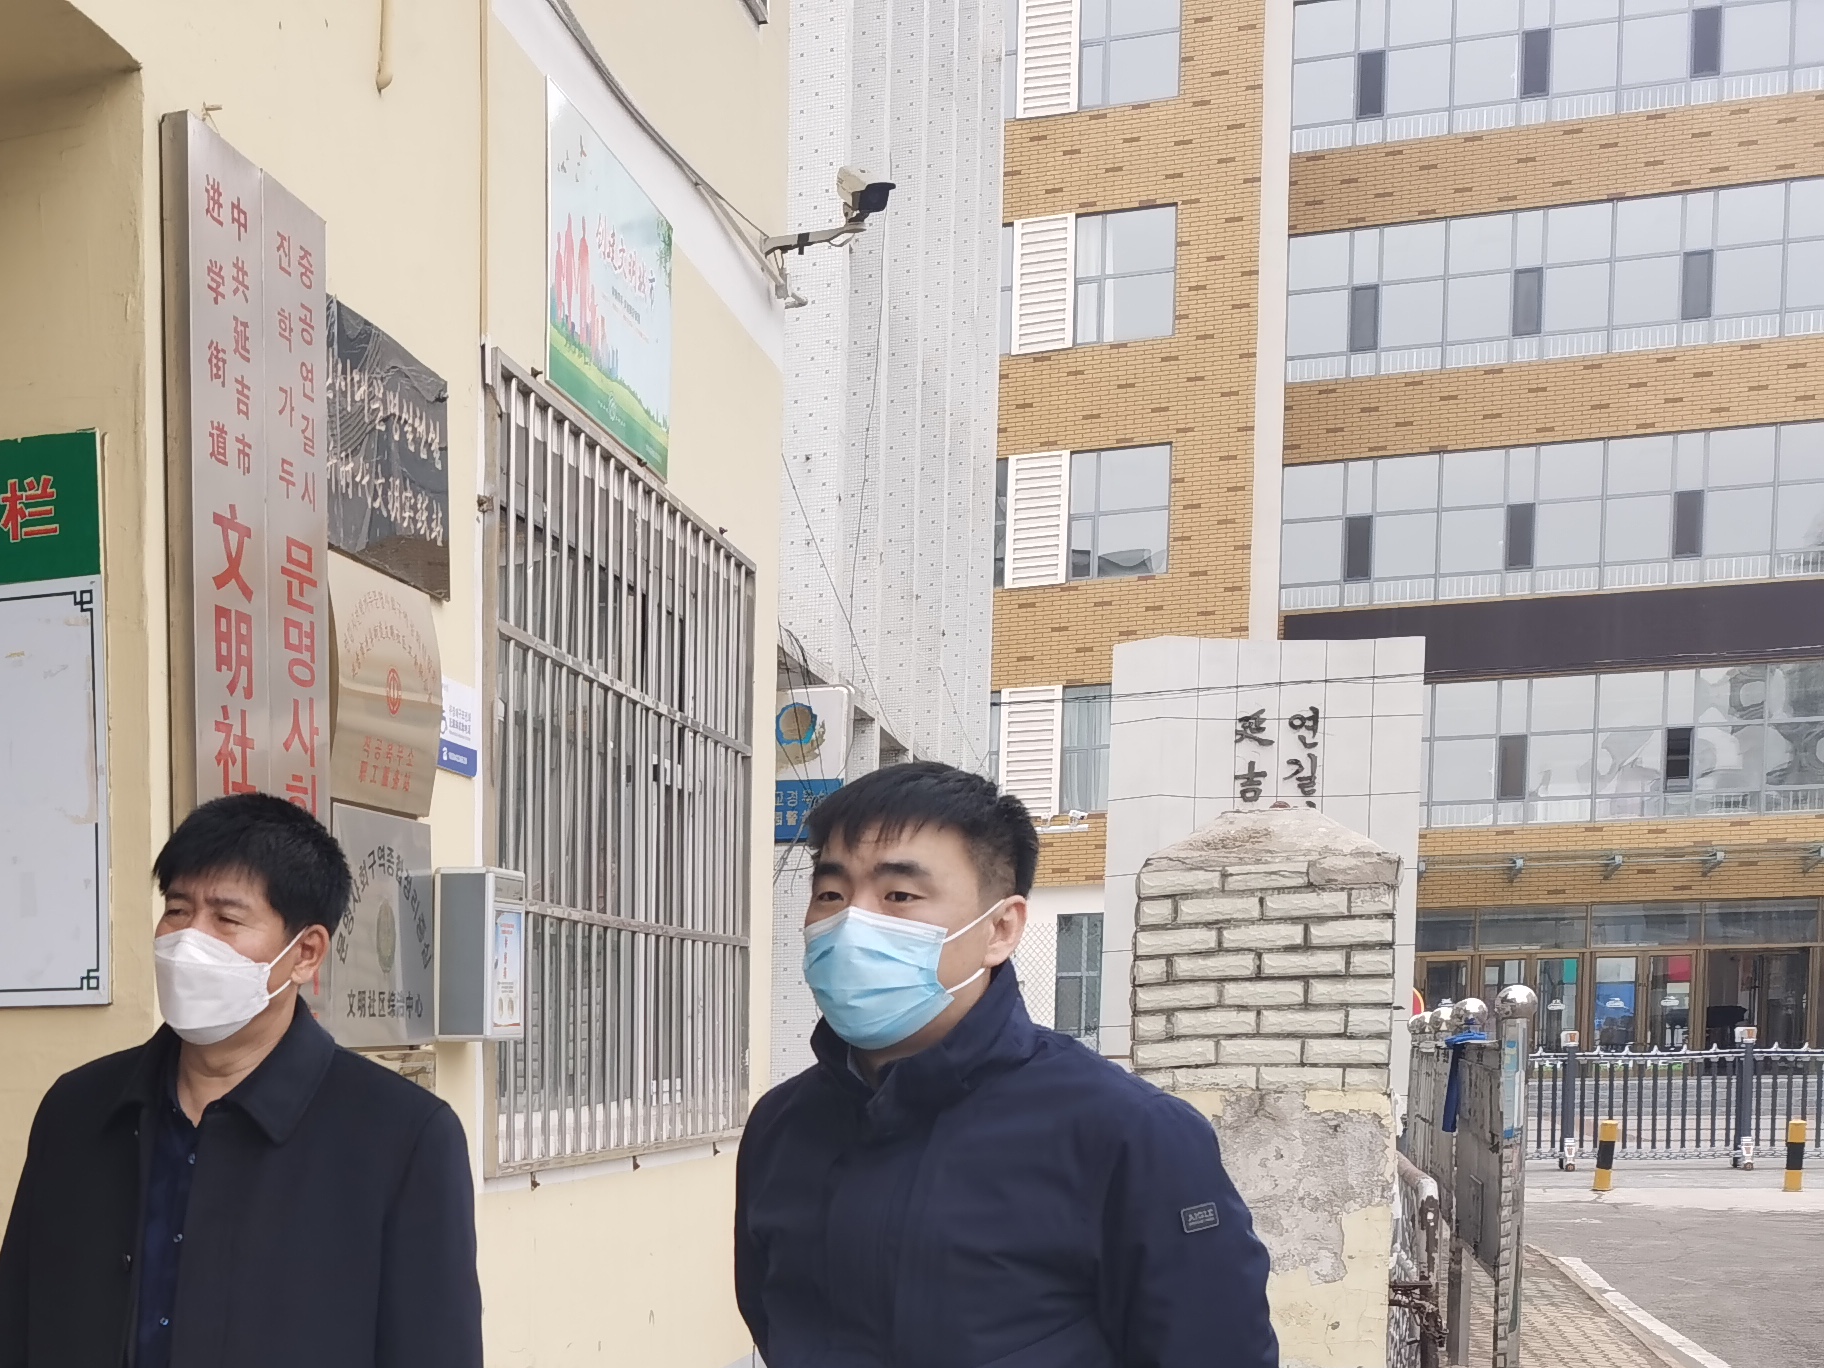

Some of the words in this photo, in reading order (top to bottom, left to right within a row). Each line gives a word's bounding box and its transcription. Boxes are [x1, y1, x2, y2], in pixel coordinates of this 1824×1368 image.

[205, 173, 229, 467] 进学街道
[230, 196, 252, 476] 中共延吉市
[276, 230, 296, 500] 진학가두
[297, 244, 317, 513] 중공연길시
[1187, 1208, 1214, 1222] AIGLE
